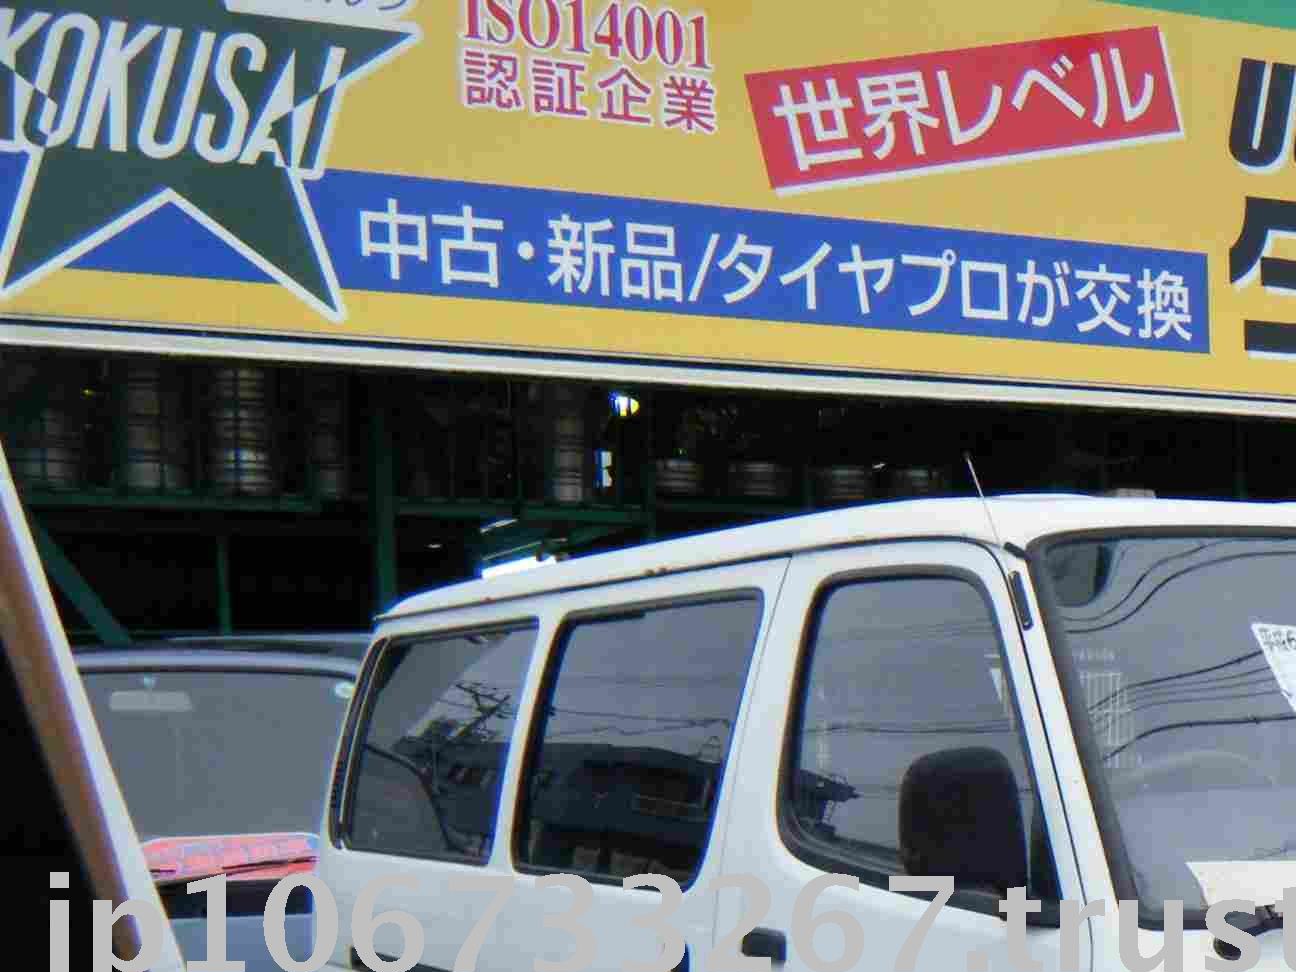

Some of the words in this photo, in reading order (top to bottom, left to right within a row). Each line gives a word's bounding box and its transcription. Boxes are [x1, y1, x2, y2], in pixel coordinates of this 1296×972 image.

[463, 0, 713, 70] ISO14001
[0, 7, 346, 179] KOKUSAI
[463, 49, 716, 133] 認証企業
[773, 46, 1156, 171] 世界レベル
